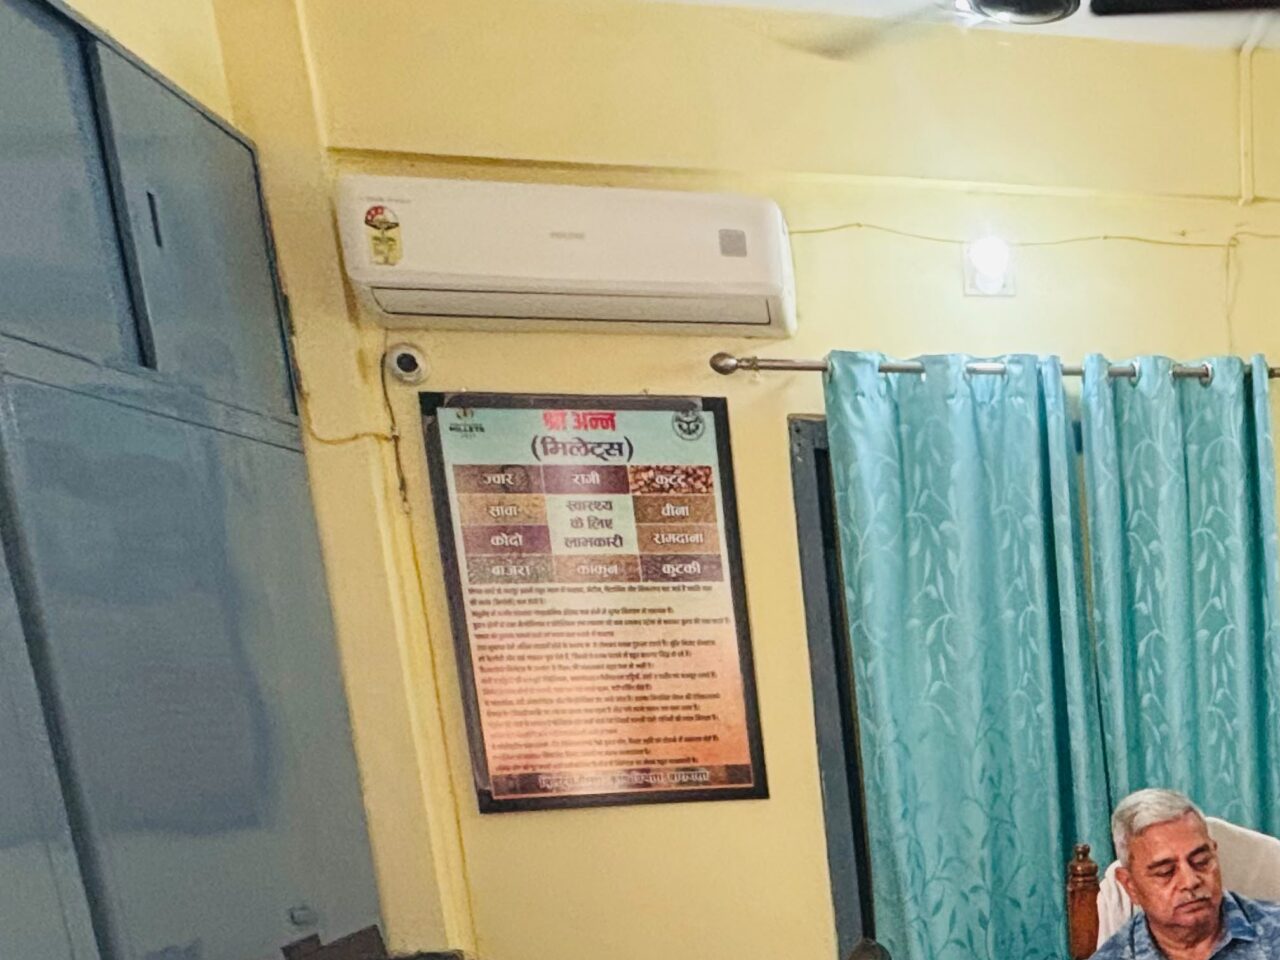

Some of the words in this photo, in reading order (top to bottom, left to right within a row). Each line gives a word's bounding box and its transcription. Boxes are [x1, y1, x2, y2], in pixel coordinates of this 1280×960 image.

[572, 411, 616, 432] अन्न
[530, 435, 634, 463] (मिलेट्स)
[571, 517, 585, 530] के
[587, 517, 613, 530] लिए
[564, 534, 623, 549] लाभकारी
